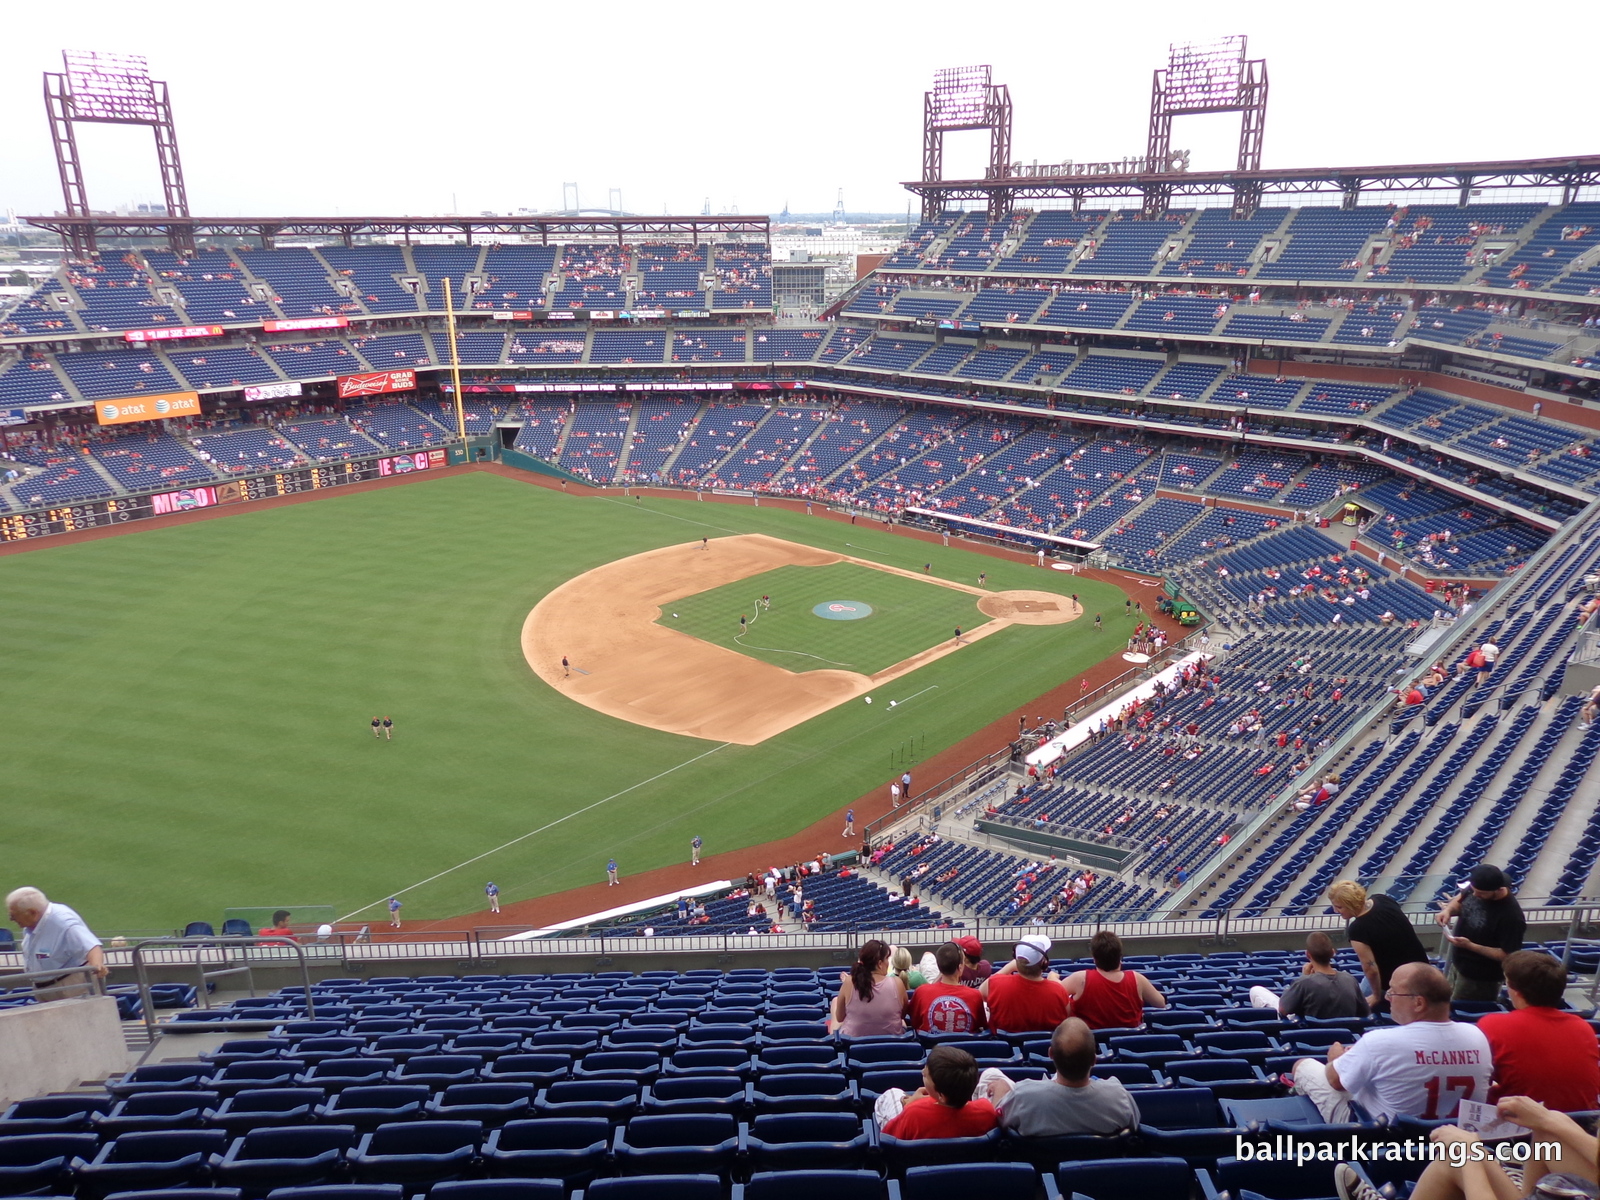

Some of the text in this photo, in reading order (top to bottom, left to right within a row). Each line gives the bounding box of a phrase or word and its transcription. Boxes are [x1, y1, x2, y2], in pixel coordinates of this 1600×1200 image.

[390, 371, 413, 379] GRAB
[340, 379, 389, 392] Budweiser
[391, 381, 414, 389] BUDS
[121, 403, 147, 416] at&t
[172, 398, 196, 410] at&t
[1414, 1050, 1480, 1066] McCANNEY
[1421, 1076, 1476, 1120] 17
